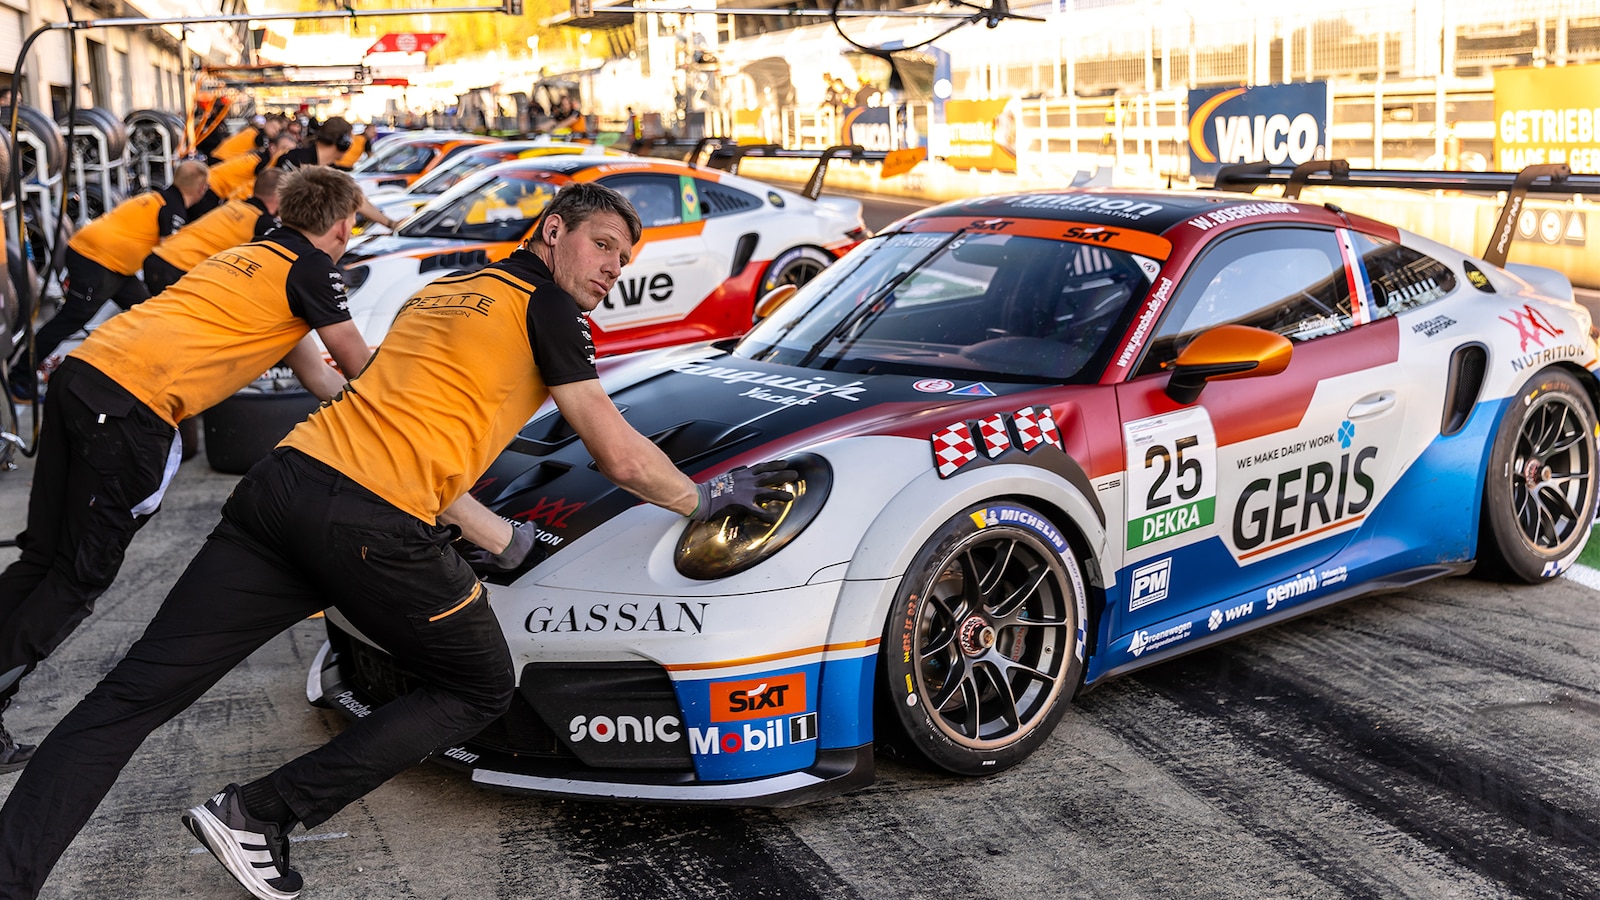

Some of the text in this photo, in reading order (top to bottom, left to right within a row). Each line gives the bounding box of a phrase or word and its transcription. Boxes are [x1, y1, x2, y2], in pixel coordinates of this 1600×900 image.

[1214, 113, 1319, 165] VAICO
[1087, 207, 1141, 221] HEATING
[1063, 227, 1121, 243] SIXT
[1117, 277, 1173, 368] www.porsche.de/pccd
[1423, 319, 1458, 338] MOTORS
[1498, 304, 1565, 353] XXL
[1510, 344, 1585, 373] NUTRITION
[1236, 432, 1336, 470] WE MAKE DAIRY WORK
[1144, 434, 1203, 511] 25
[512, 496, 587, 529] XXL
[1232, 446, 1378, 551] GERIS
[1000, 509, 1064, 549] MICHELIN
[1142, 504, 1200, 543] DEKRA
[1067, 556, 1079, 579] PILOT
[1076, 581, 1085, 609] SPORT
[1133, 569, 1168, 600] PM
[1266, 568, 1318, 610] gemini
[524, 602, 711, 634] GASSAN
[1225, 601, 1254, 622] WVH
[1140, 621, 1193, 645] Groenewegen
[335, 690, 373, 718] Porsche
[729, 683, 789, 713] SIXT
[689, 719, 784, 755] Mobil
